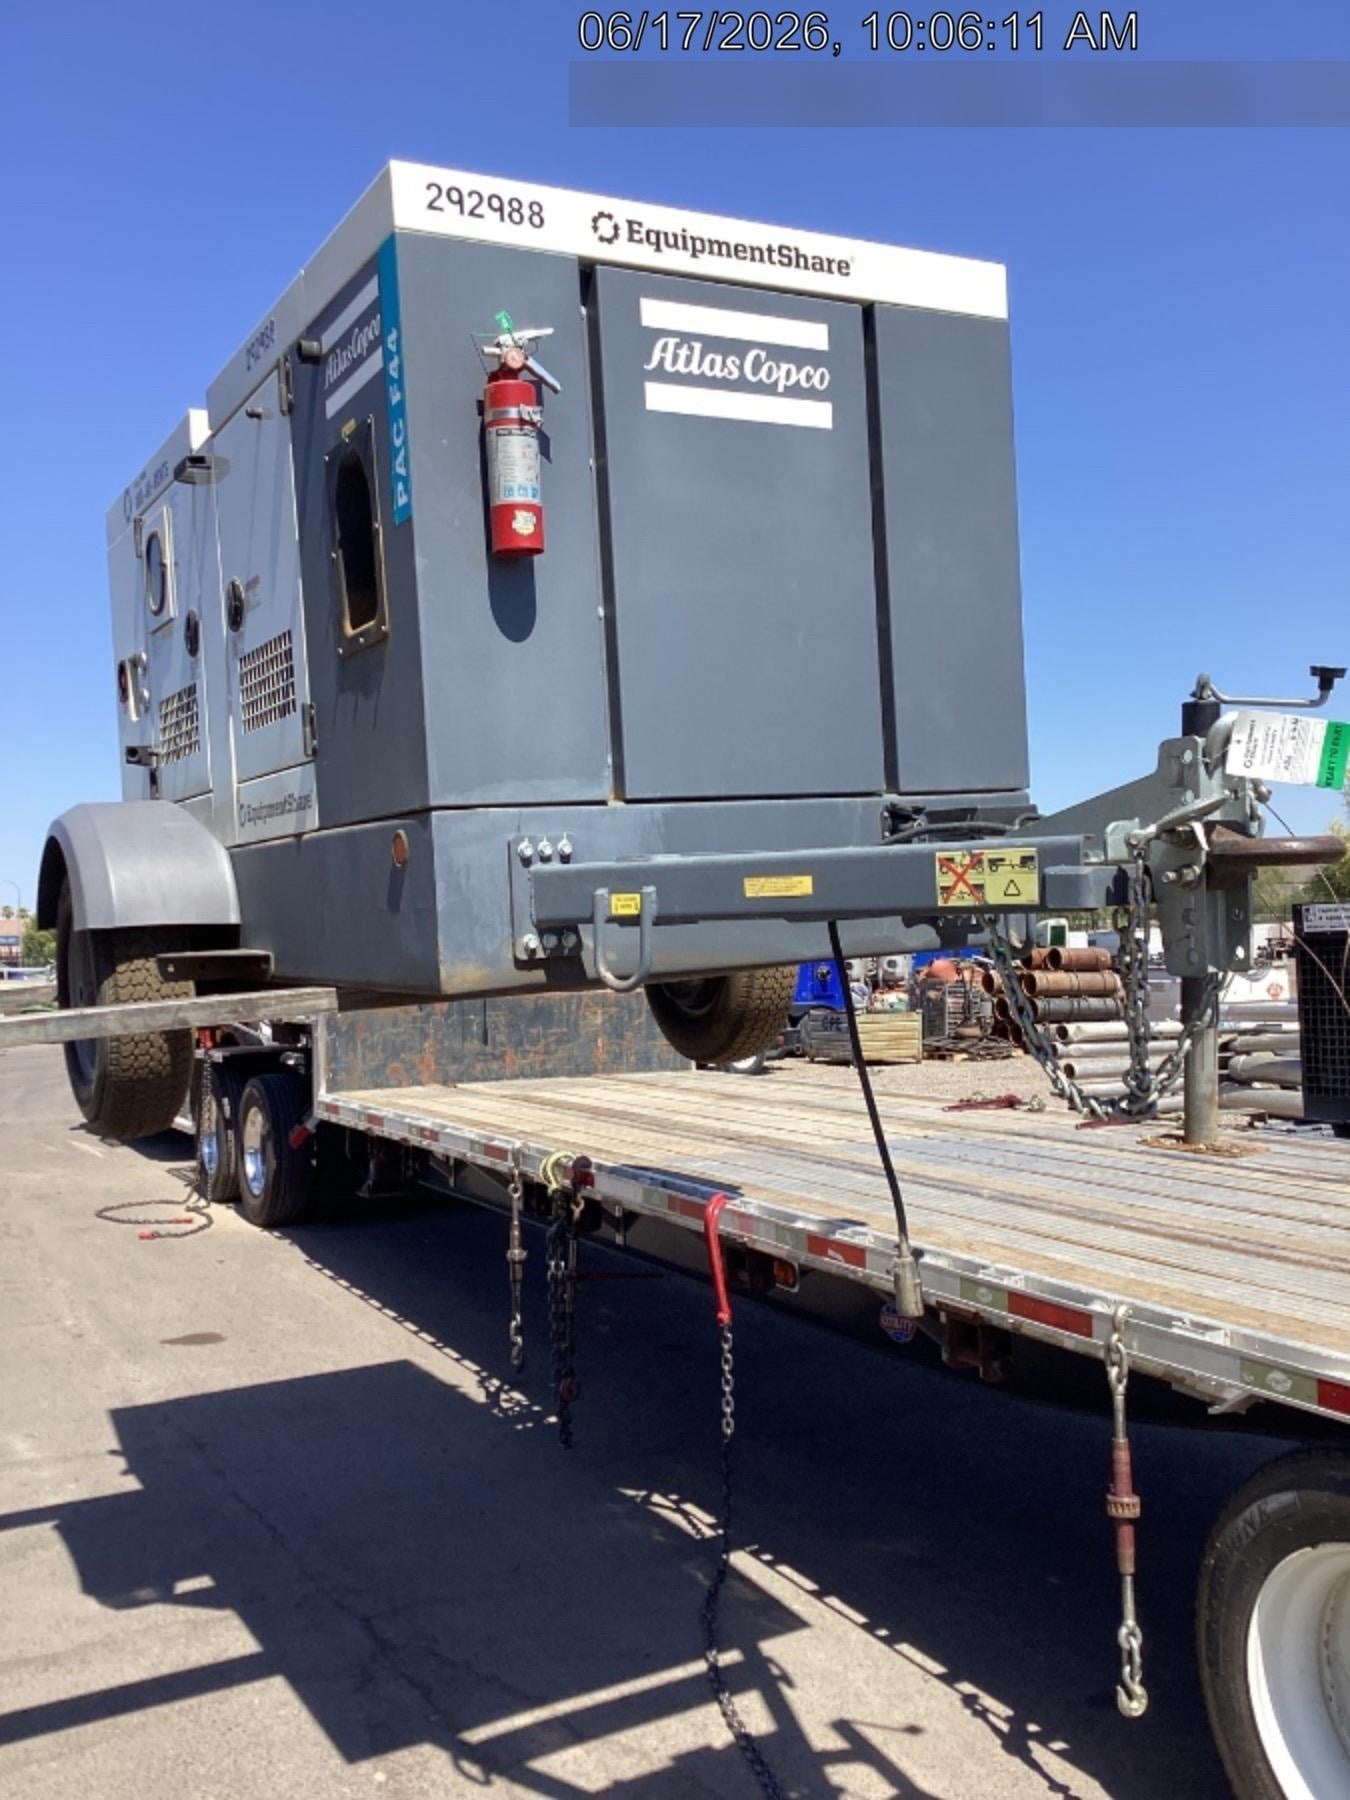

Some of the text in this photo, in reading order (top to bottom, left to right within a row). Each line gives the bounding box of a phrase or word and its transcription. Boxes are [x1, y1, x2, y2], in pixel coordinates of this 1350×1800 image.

[425, 182, 545, 229] 292988
[626, 219, 851, 277] EquipmentShare
[643, 337, 831, 392] Atlas Copco
[393, 417, 408, 508] PAC
